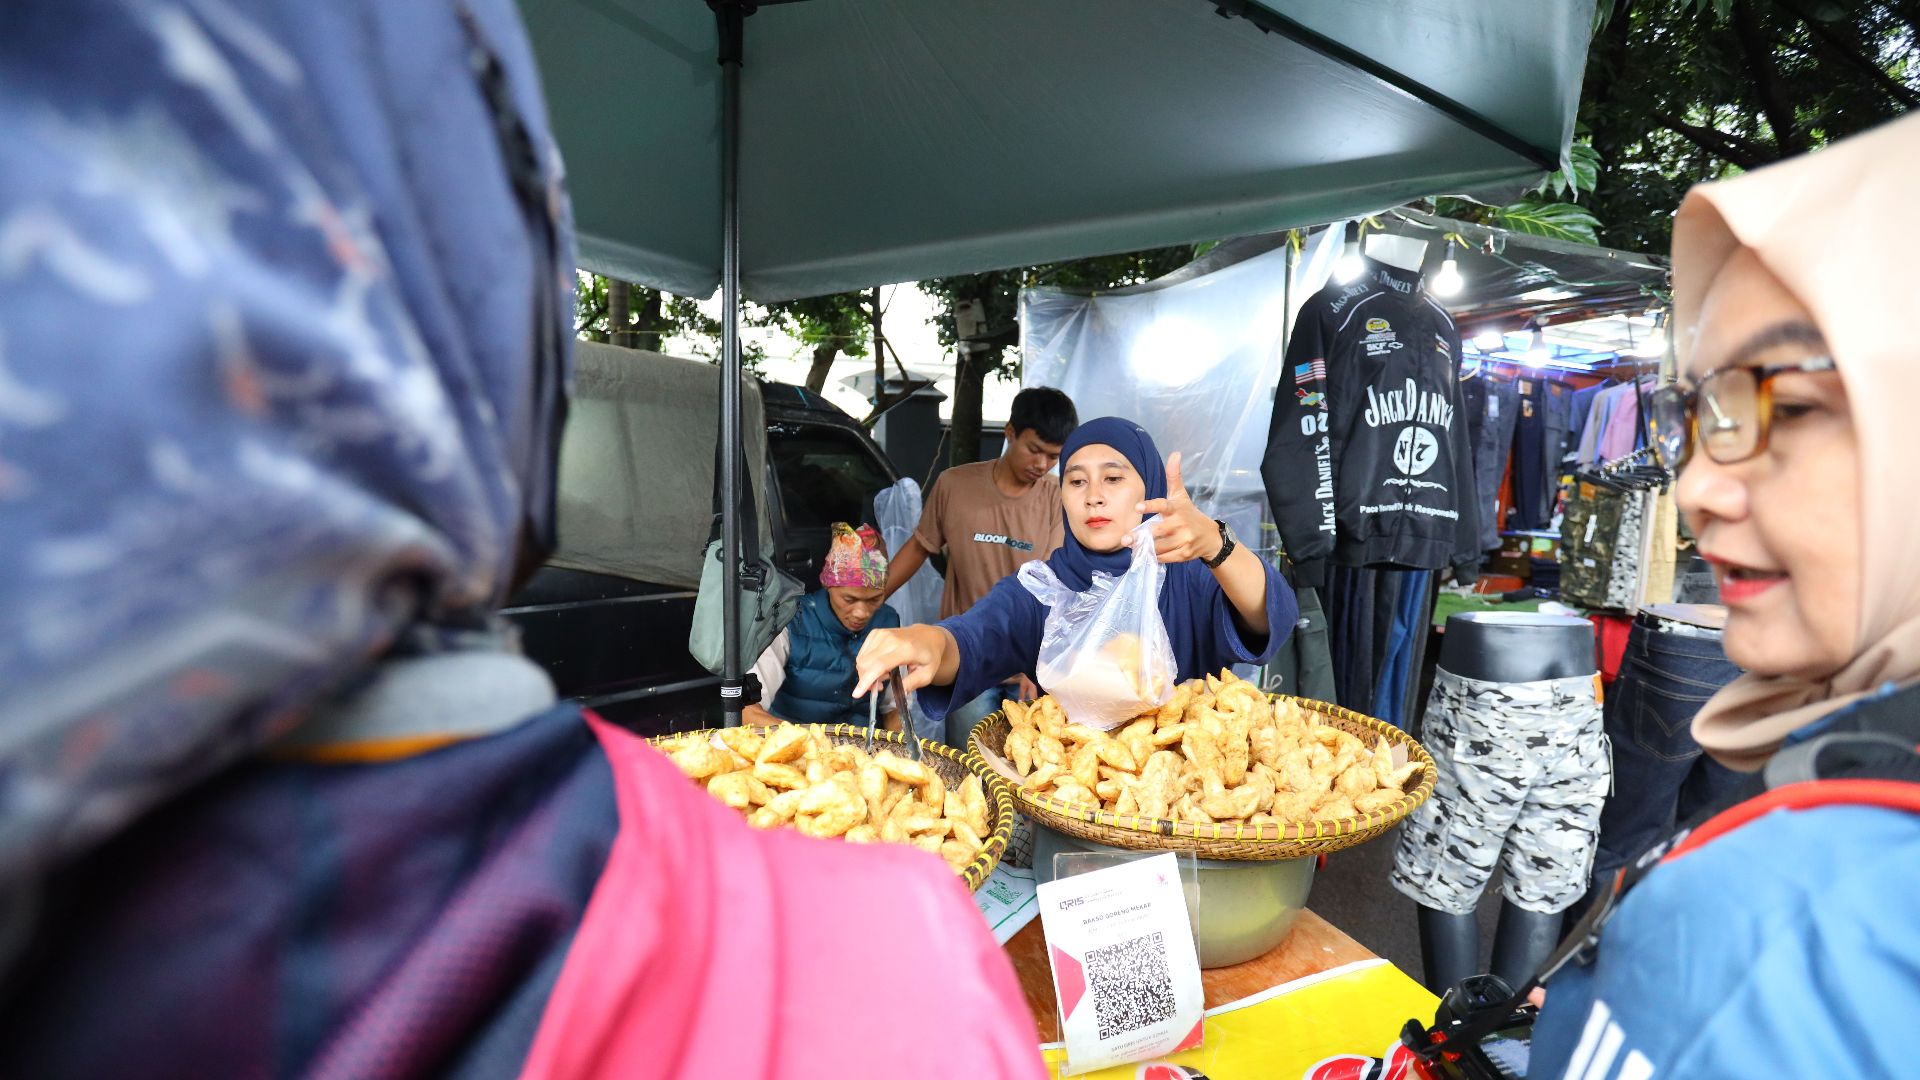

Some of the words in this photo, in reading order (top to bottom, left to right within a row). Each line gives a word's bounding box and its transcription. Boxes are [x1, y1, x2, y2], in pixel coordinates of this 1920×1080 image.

[1365, 384, 1405, 427] JACK
[1059, 897, 1084, 911] QRIS
[1082, 914, 1104, 925] BAKSO
[1105, 907, 1130, 919] GORENG
[1130, 901, 1152, 911] MEKAR
